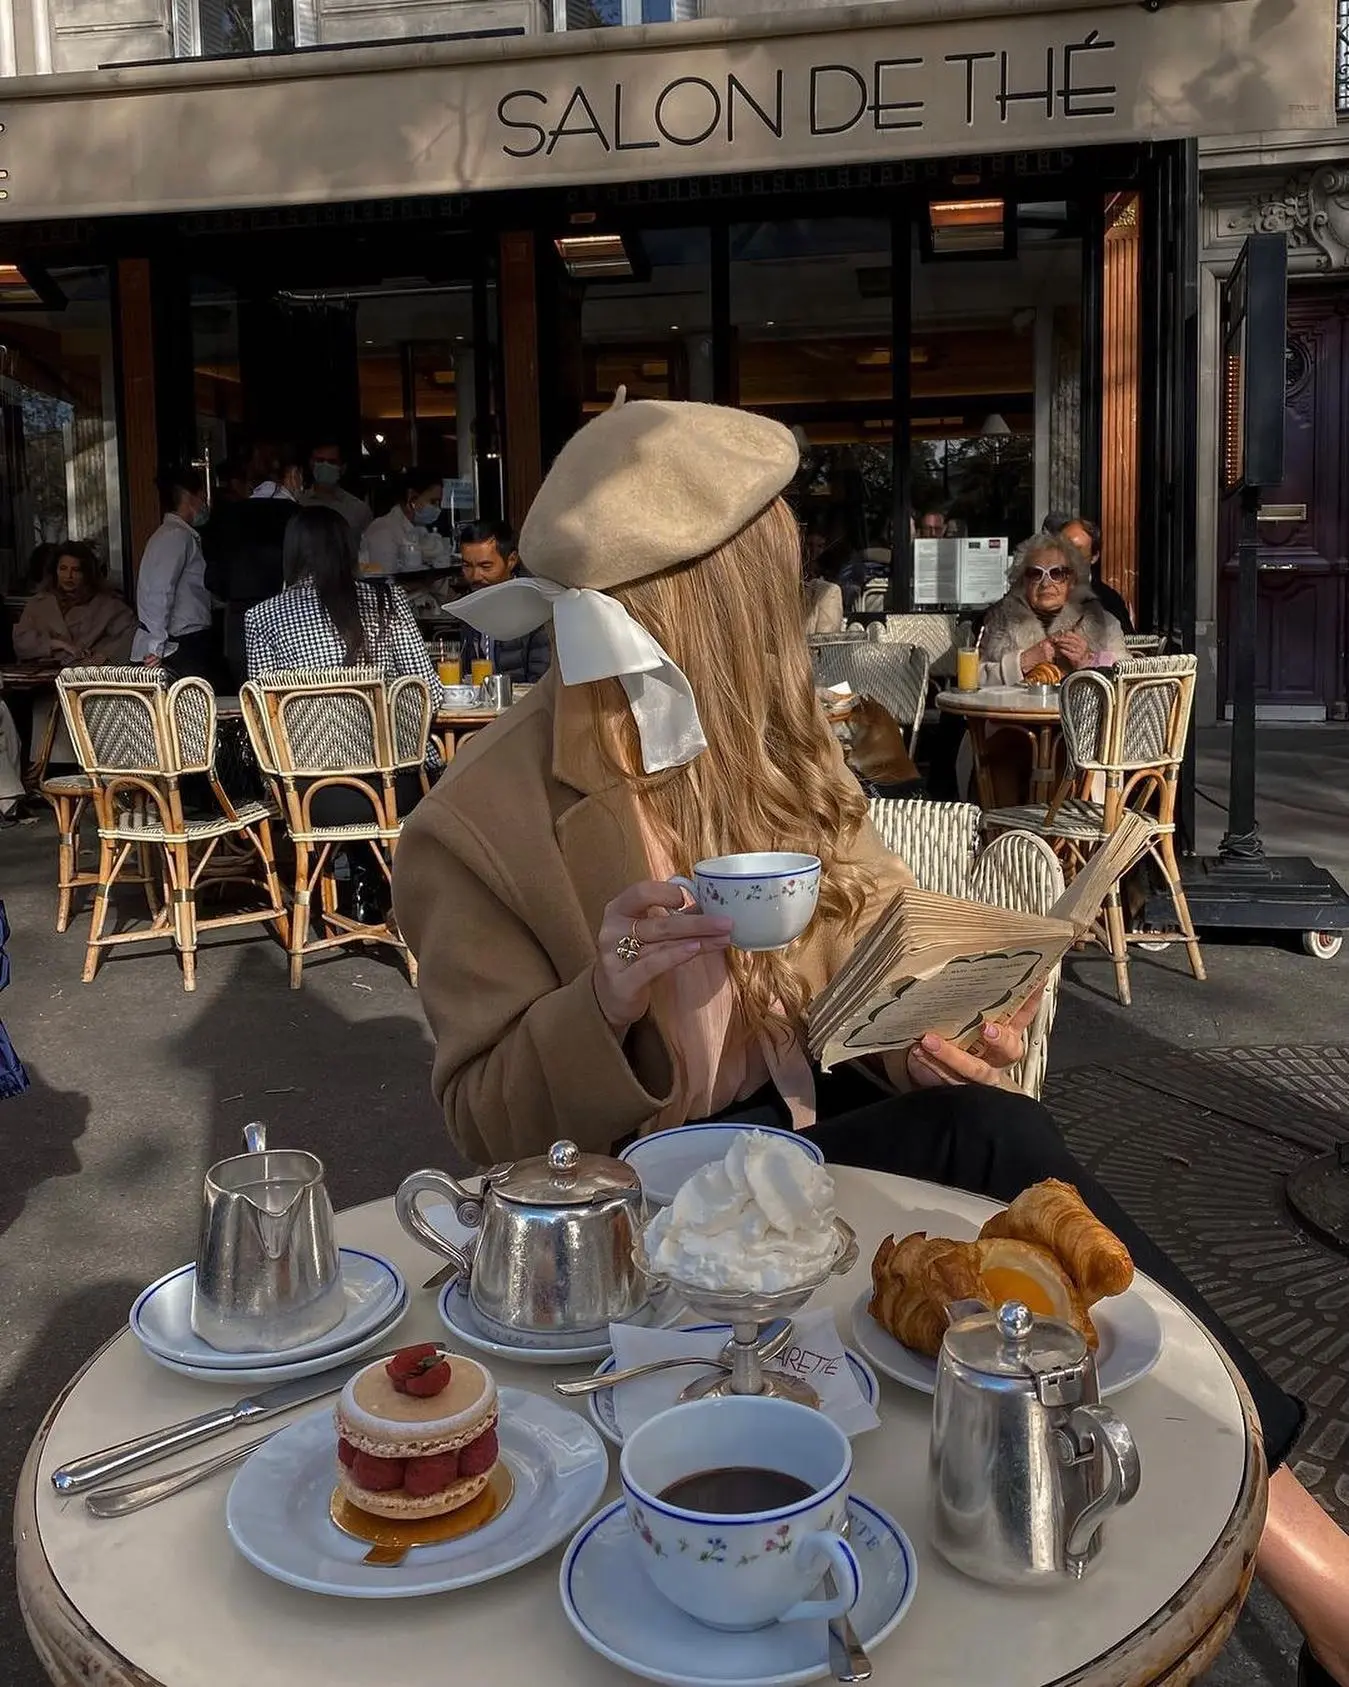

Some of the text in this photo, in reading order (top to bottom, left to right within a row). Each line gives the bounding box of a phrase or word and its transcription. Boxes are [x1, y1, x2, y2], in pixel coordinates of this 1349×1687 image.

[497, 30, 1116, 157] SALON DE THÉ
[774, 1345, 839, 1376] ARETTE
